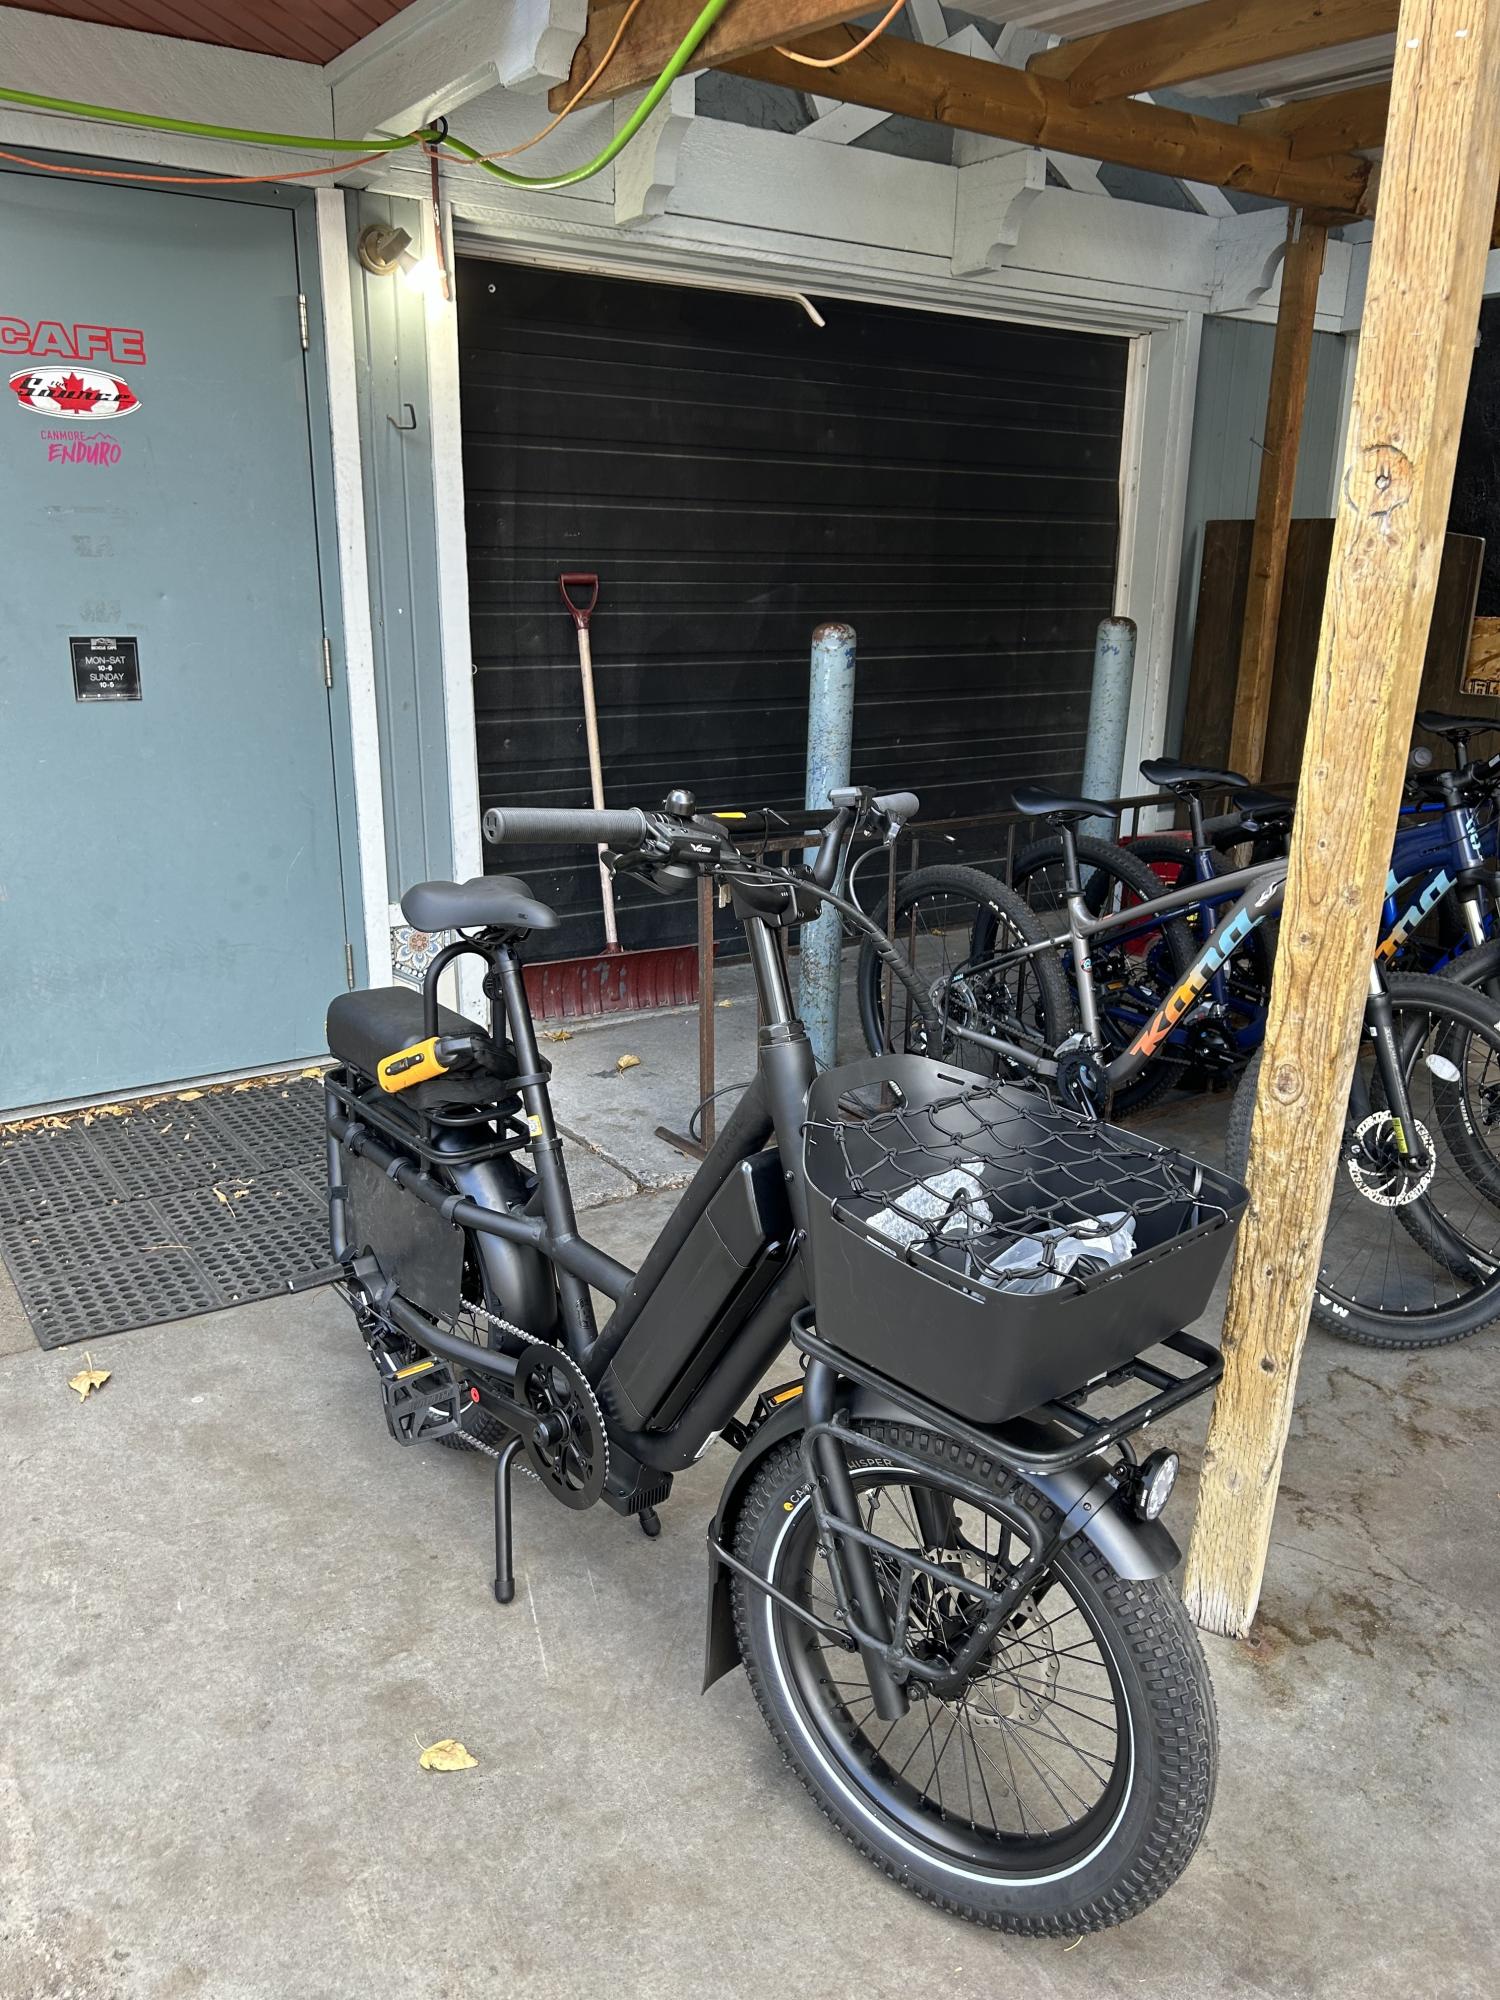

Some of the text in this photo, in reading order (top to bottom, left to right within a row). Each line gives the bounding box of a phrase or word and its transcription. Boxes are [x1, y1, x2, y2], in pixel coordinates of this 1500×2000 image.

[0, 316, 147, 365] CAFE
[40, 430, 86, 441] CANMORE
[48, 441, 122, 467] ENDURO
[85, 656, 126, 664] MON-SAT
[90, 673, 125, 681] SUNDAY
[846, 1458, 895, 1470] HISPER
